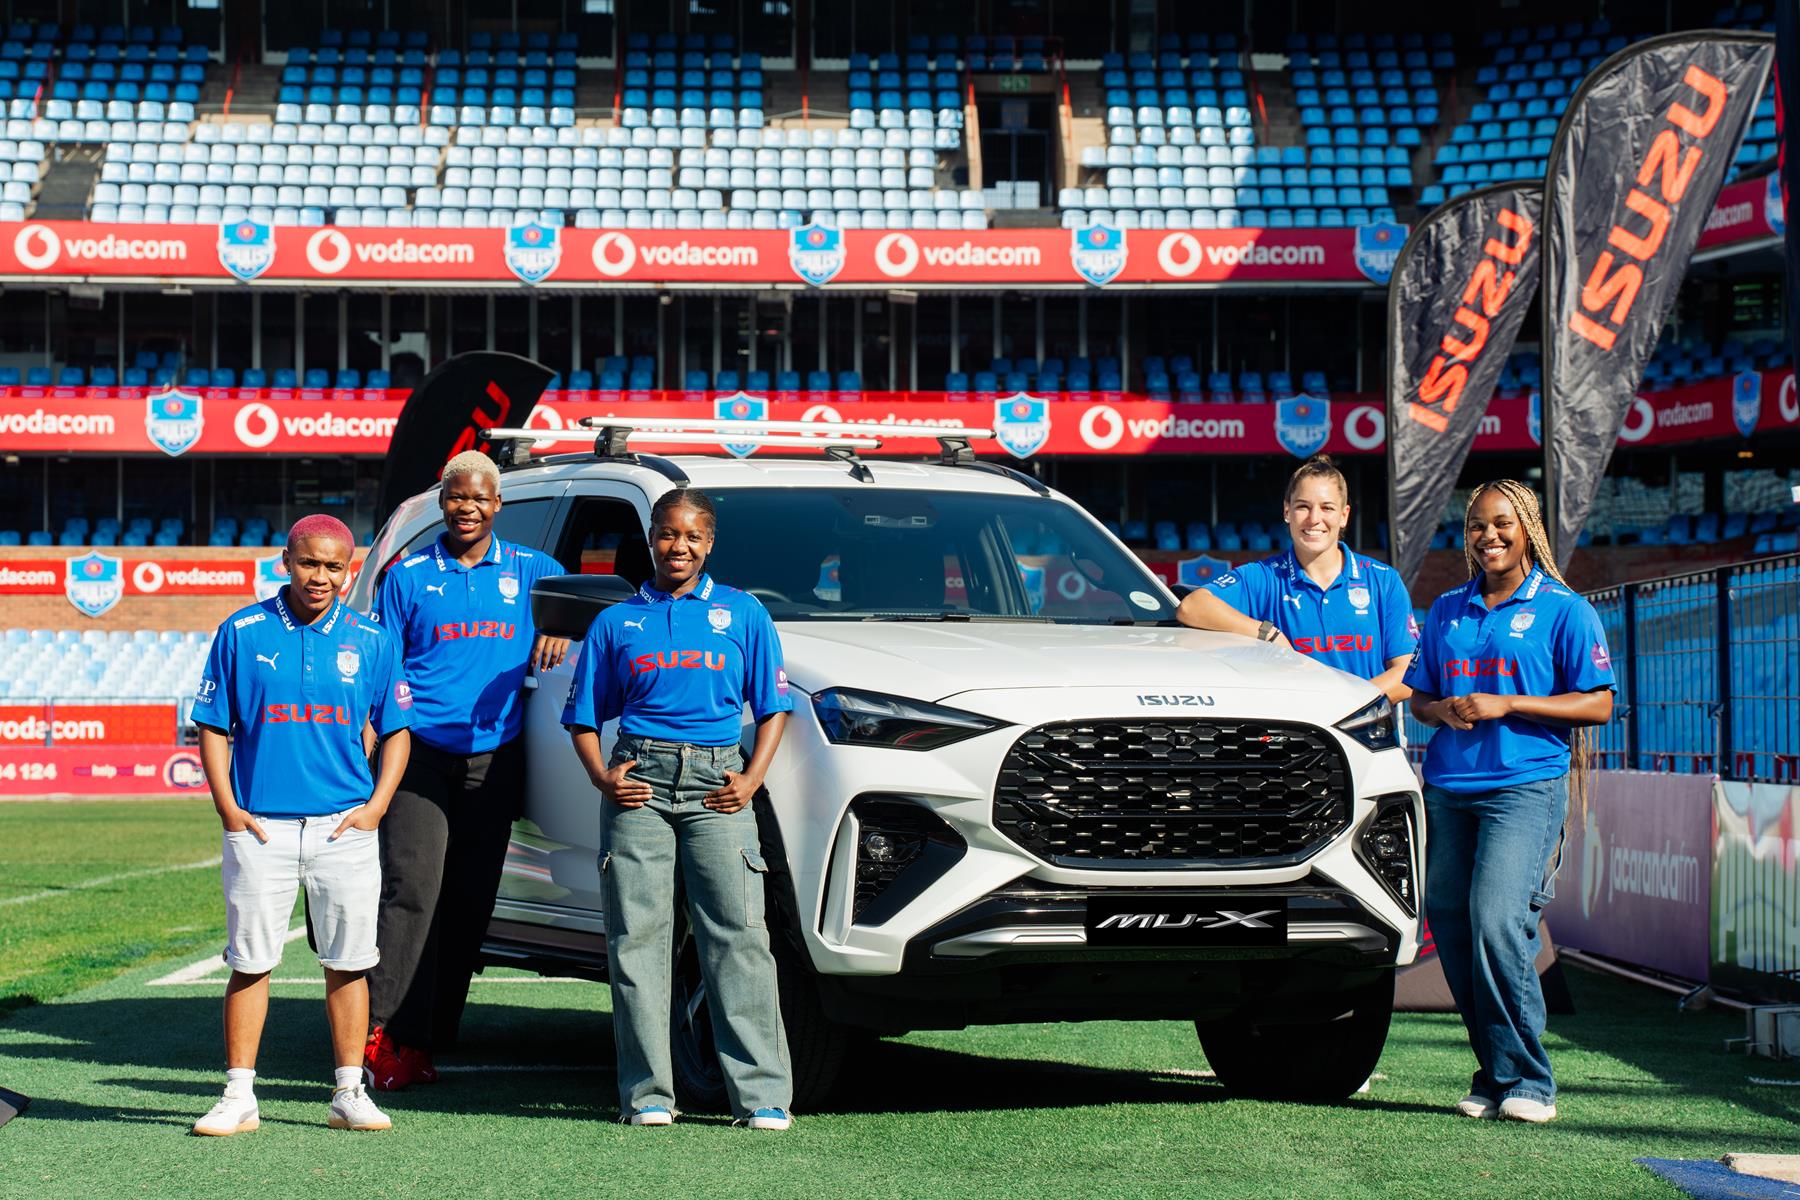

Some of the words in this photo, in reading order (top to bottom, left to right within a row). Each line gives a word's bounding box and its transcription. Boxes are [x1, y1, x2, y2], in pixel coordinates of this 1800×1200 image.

[1569, 64, 1729, 352] ISUZU
[65, 234, 187, 260] vodacom
[355, 239, 475, 264] vodacom
[640, 240, 758, 266] vodacom
[923, 241, 1041, 266] vodacom
[1206, 241, 1325, 265] vodacom
[1408, 207, 1534, 433] ISUZU
[0, 409, 115, 435] vodacom
[1127, 414, 1244, 439] vodacom
[1657, 402, 1713, 427] vodacom
[166, 568, 246, 586] vodacom
[233, 612, 267, 630] SSG
[275, 596, 296, 632] ISUZU
[434, 620, 516, 642] ISUZU
[1293, 634, 1373, 654] SUZU
[629, 650, 726, 678] ISUZU
[1443, 658, 1519, 680] ISUZU
[1136, 694, 1216, 707] ISUZU
[261, 703, 351, 725] ISUZU
[0, 715, 105, 740] odacom
[19, 762, 57, 780] 124
[1608, 834, 1700, 905] jacarandafm
[1095, 910, 1282, 929] MU-X
